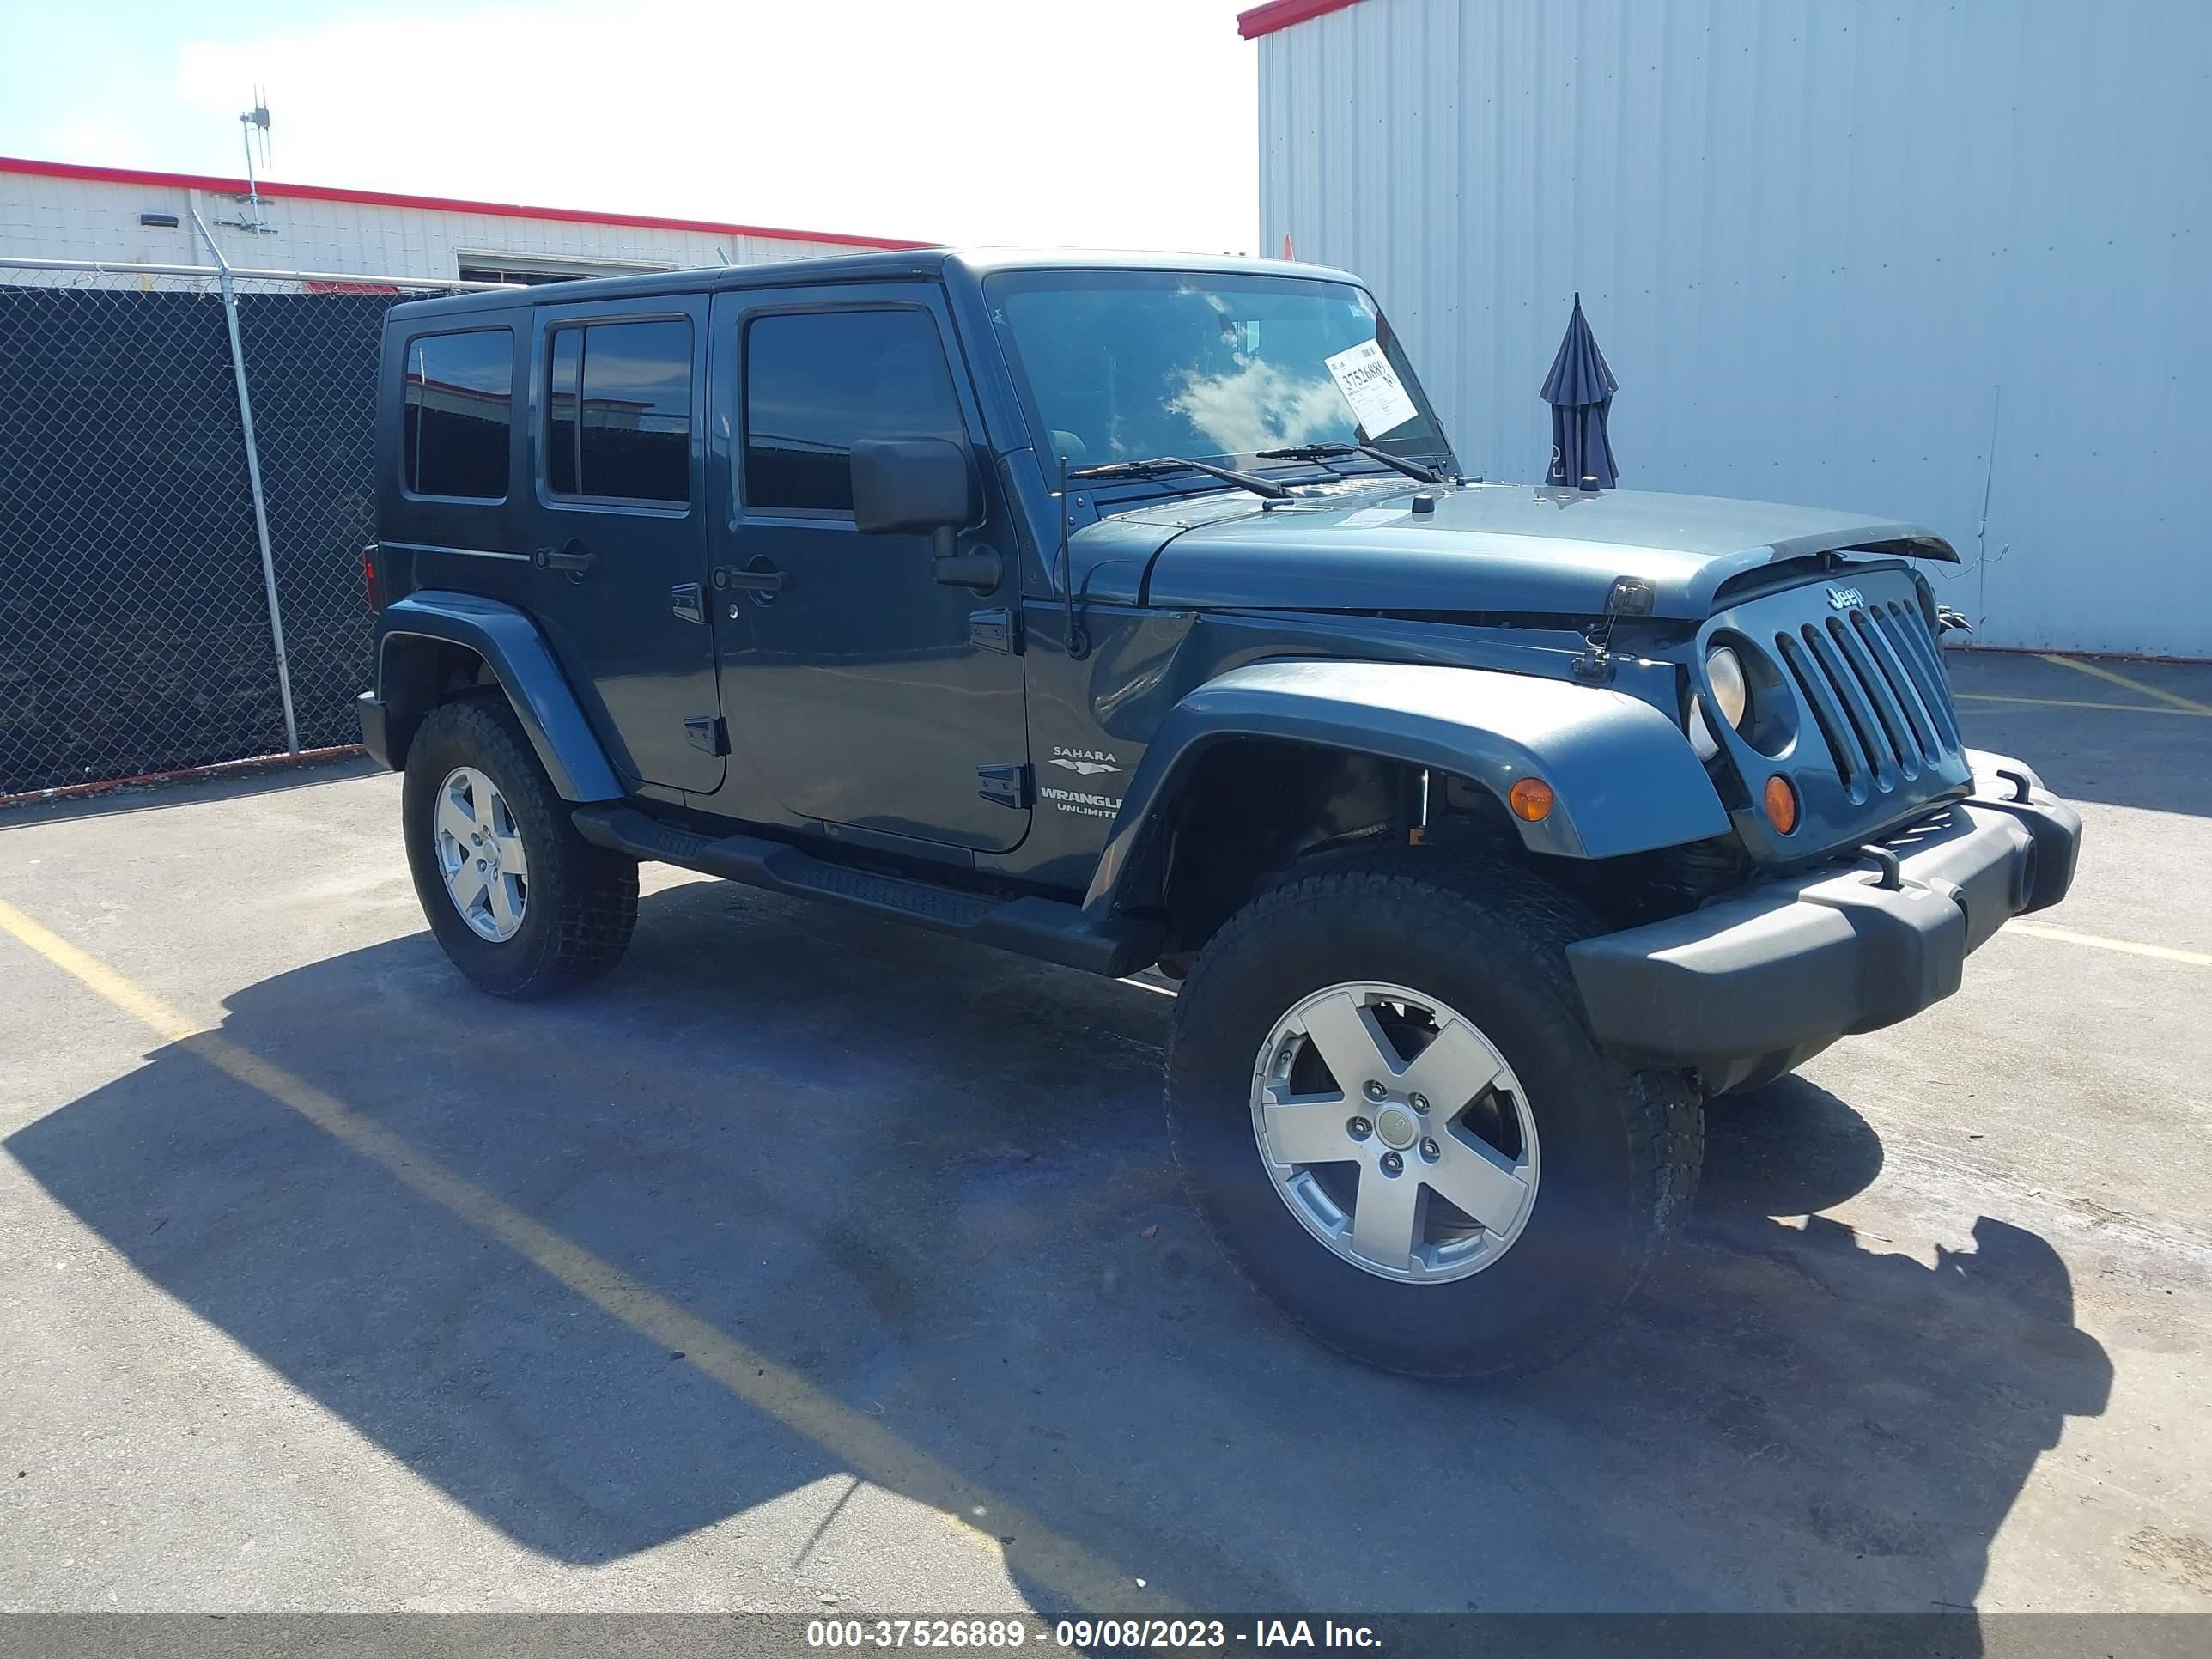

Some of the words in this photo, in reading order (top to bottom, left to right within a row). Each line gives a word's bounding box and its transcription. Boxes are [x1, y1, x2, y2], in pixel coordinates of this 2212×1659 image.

[1342, 360, 1386, 391] 37526889
[1826, 587, 1864, 611] Jeep
[1053, 746, 1117, 763] SAHARA
